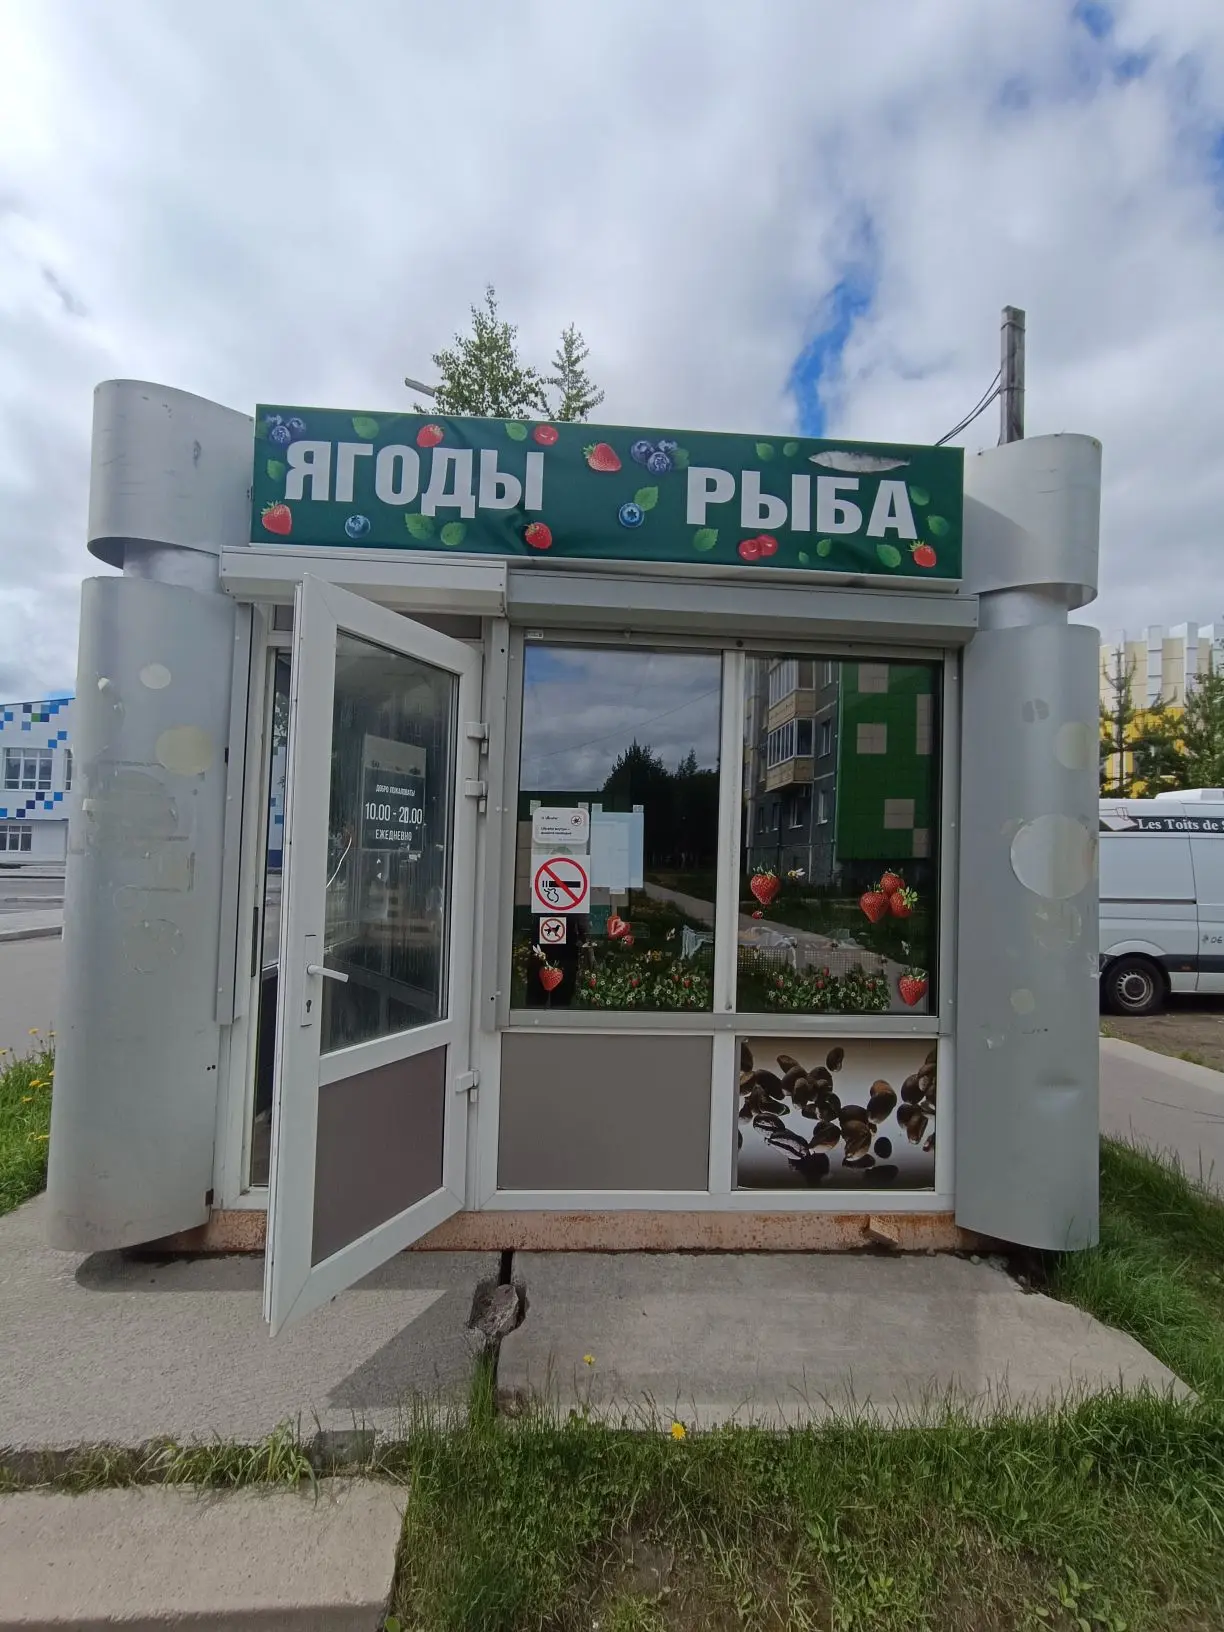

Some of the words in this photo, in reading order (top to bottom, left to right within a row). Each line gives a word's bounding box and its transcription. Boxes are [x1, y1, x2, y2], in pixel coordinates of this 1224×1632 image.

[285, 440, 543, 519] ЯГОДЫ
[687, 466, 917, 540] РЫБА
[365, 802, 391, 821] 10.00
[1137, 818, 1162, 830] Les
[1164, 818, 1199, 830] Toits
[1203, 819, 1219, 830] de
[375, 829, 412, 841] ЕЖЕДНЕВНО
